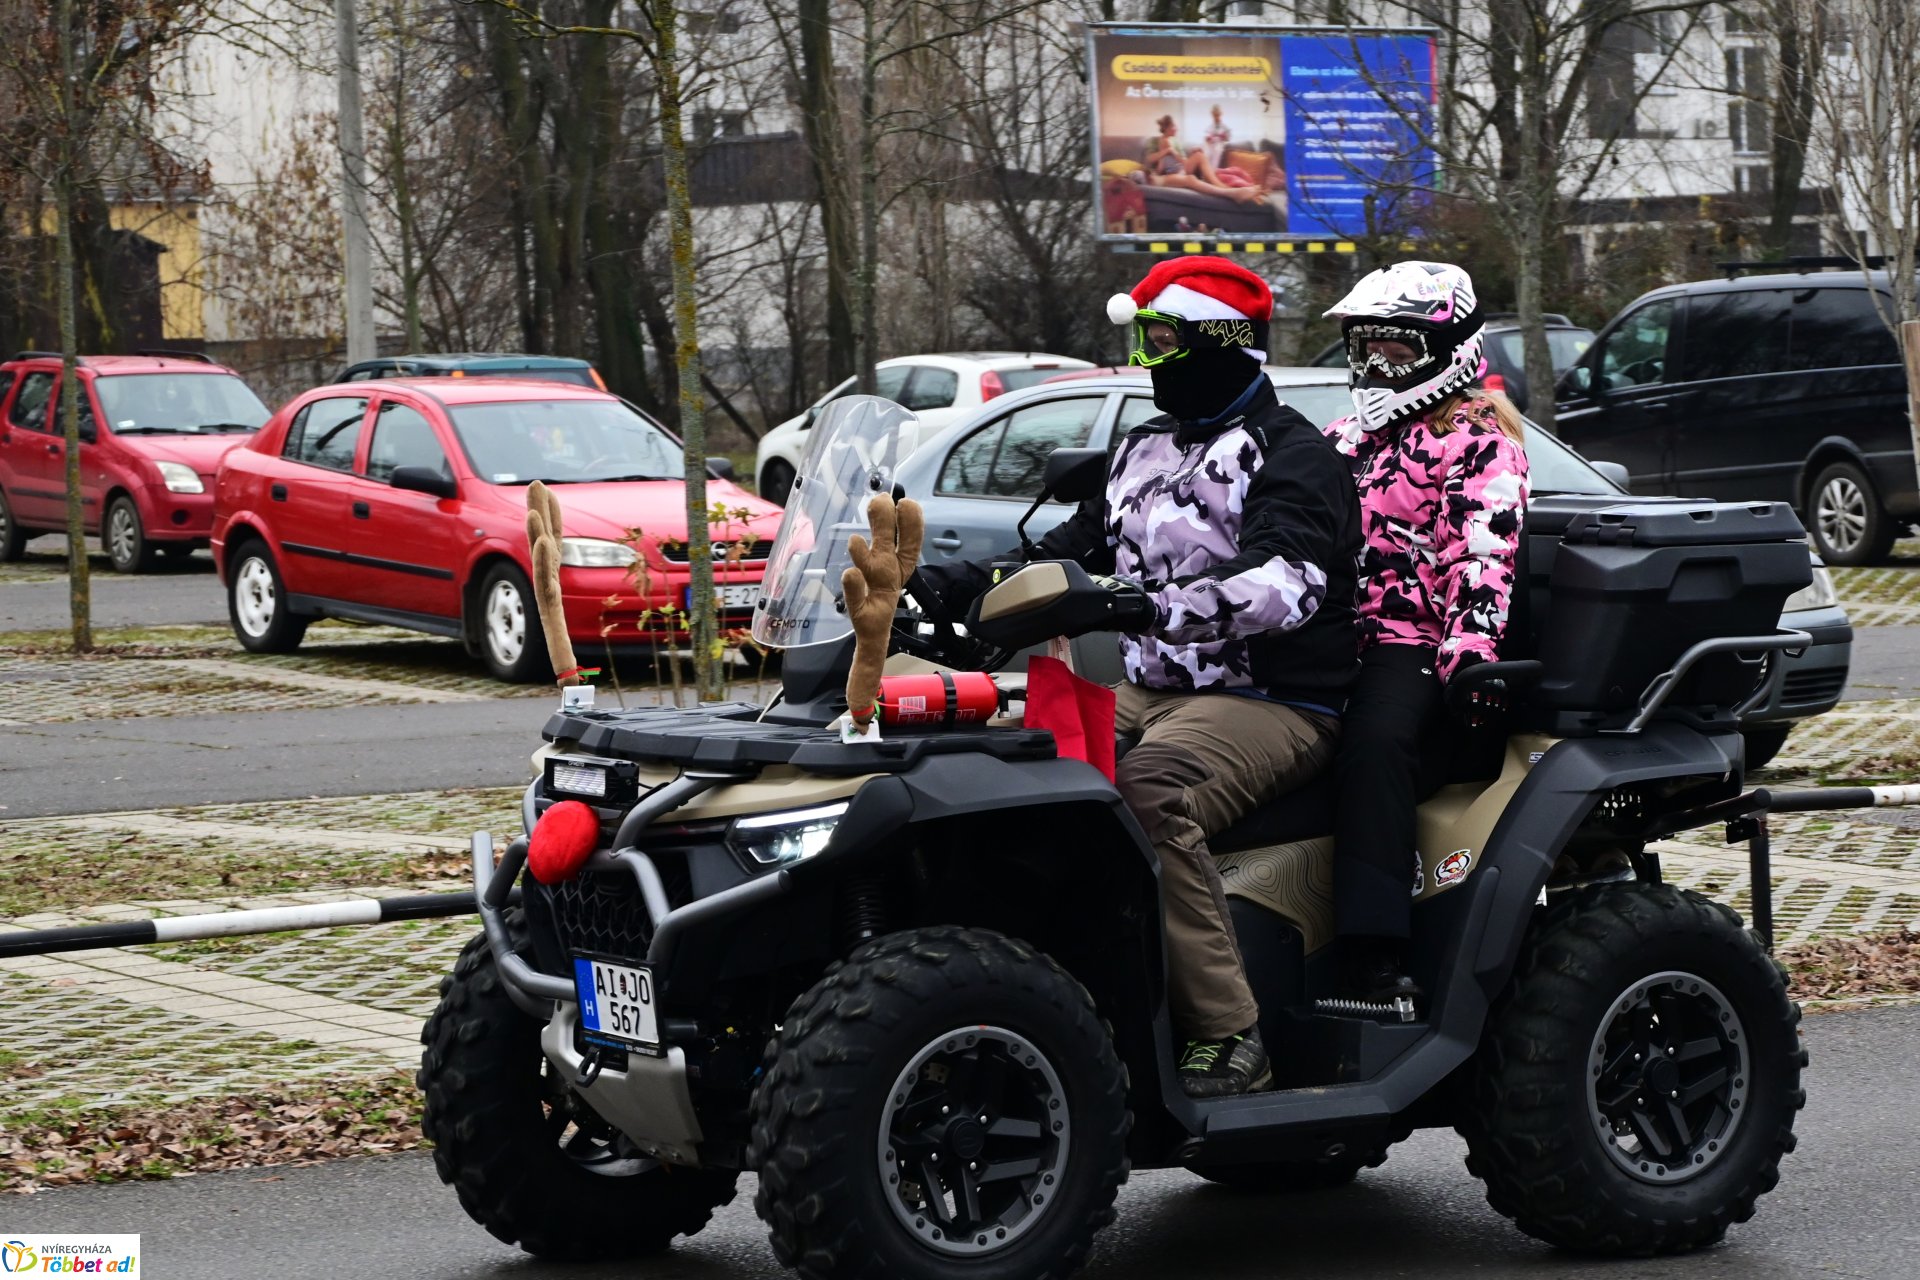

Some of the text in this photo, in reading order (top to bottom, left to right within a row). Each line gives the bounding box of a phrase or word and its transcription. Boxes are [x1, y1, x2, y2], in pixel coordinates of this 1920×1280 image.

[1122, 61, 1168, 74] Családi
[770, 619, 811, 629] CFMOTO
[584, 999, 595, 1017] H
[609, 1001, 640, 1036] 567
